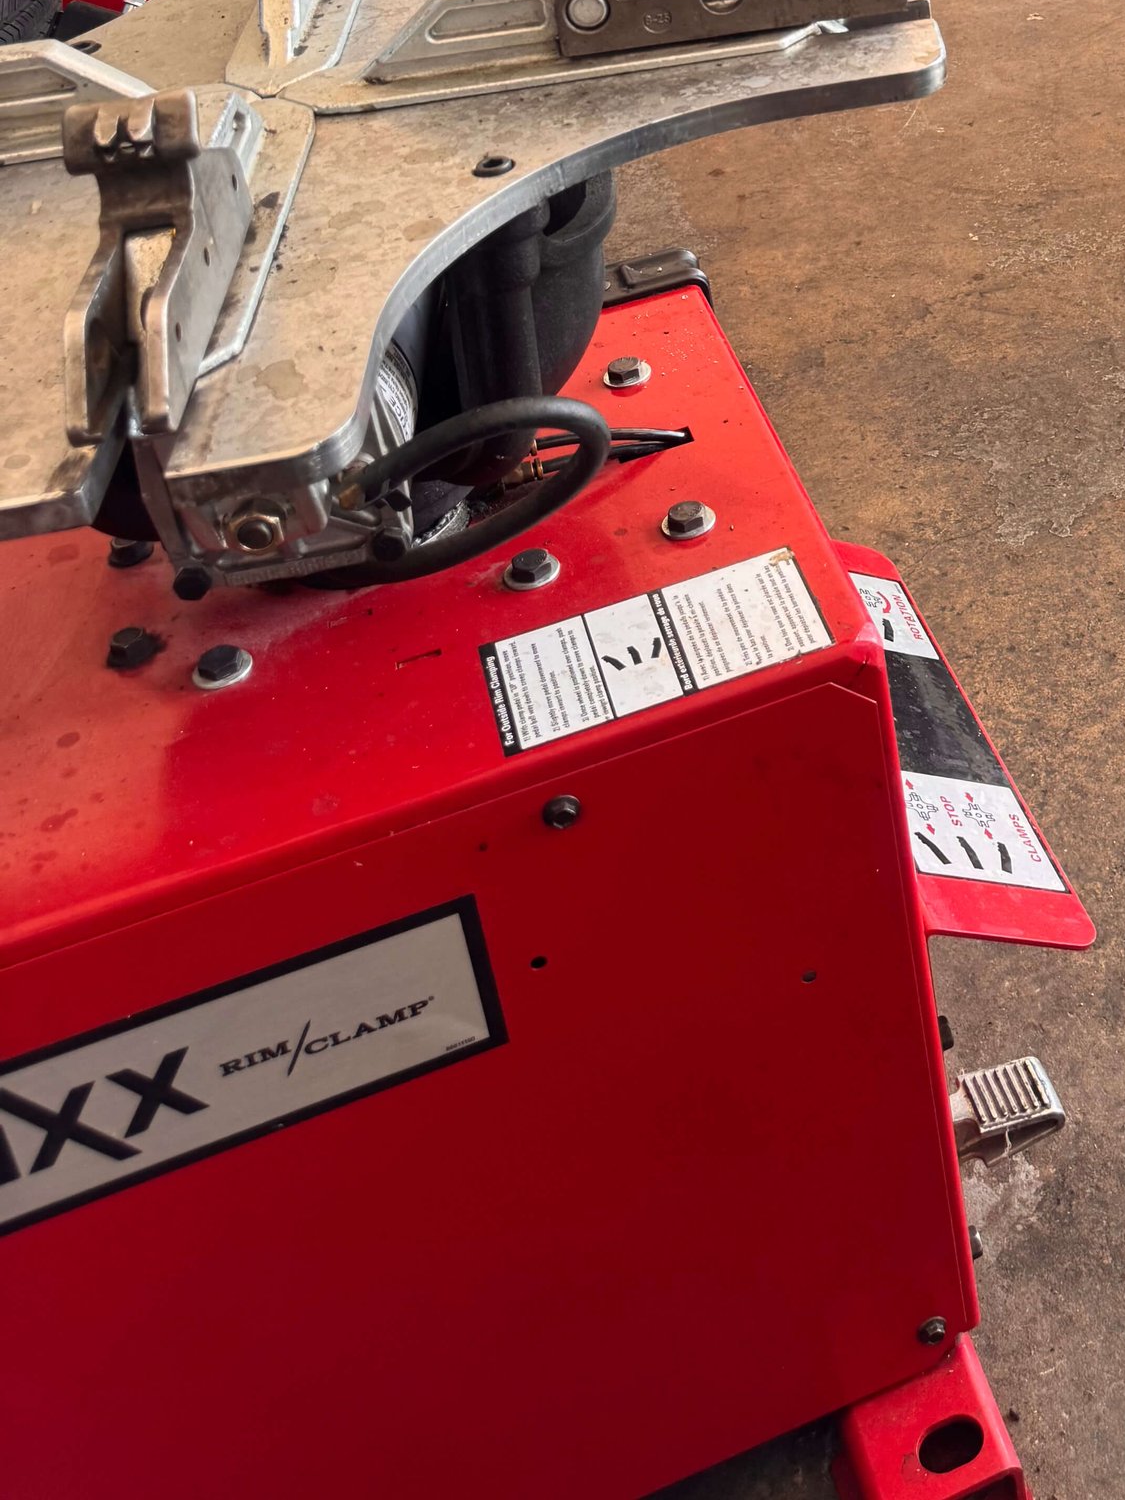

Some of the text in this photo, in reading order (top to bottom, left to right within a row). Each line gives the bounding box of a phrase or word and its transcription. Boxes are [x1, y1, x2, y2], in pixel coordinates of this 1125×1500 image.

[651, 592, 664, 607] roue
[656, 606, 667, 616] de
[659, 615, 675, 638] serrage
[892, 594, 923, 641] ROTATION
[679, 672, 693, 690] Bord
[484, 654, 516, 745] For Outside Rim Clamping
[940, 795, 963, 827] STOP
[1009, 813, 1042, 863] CLAMPS
